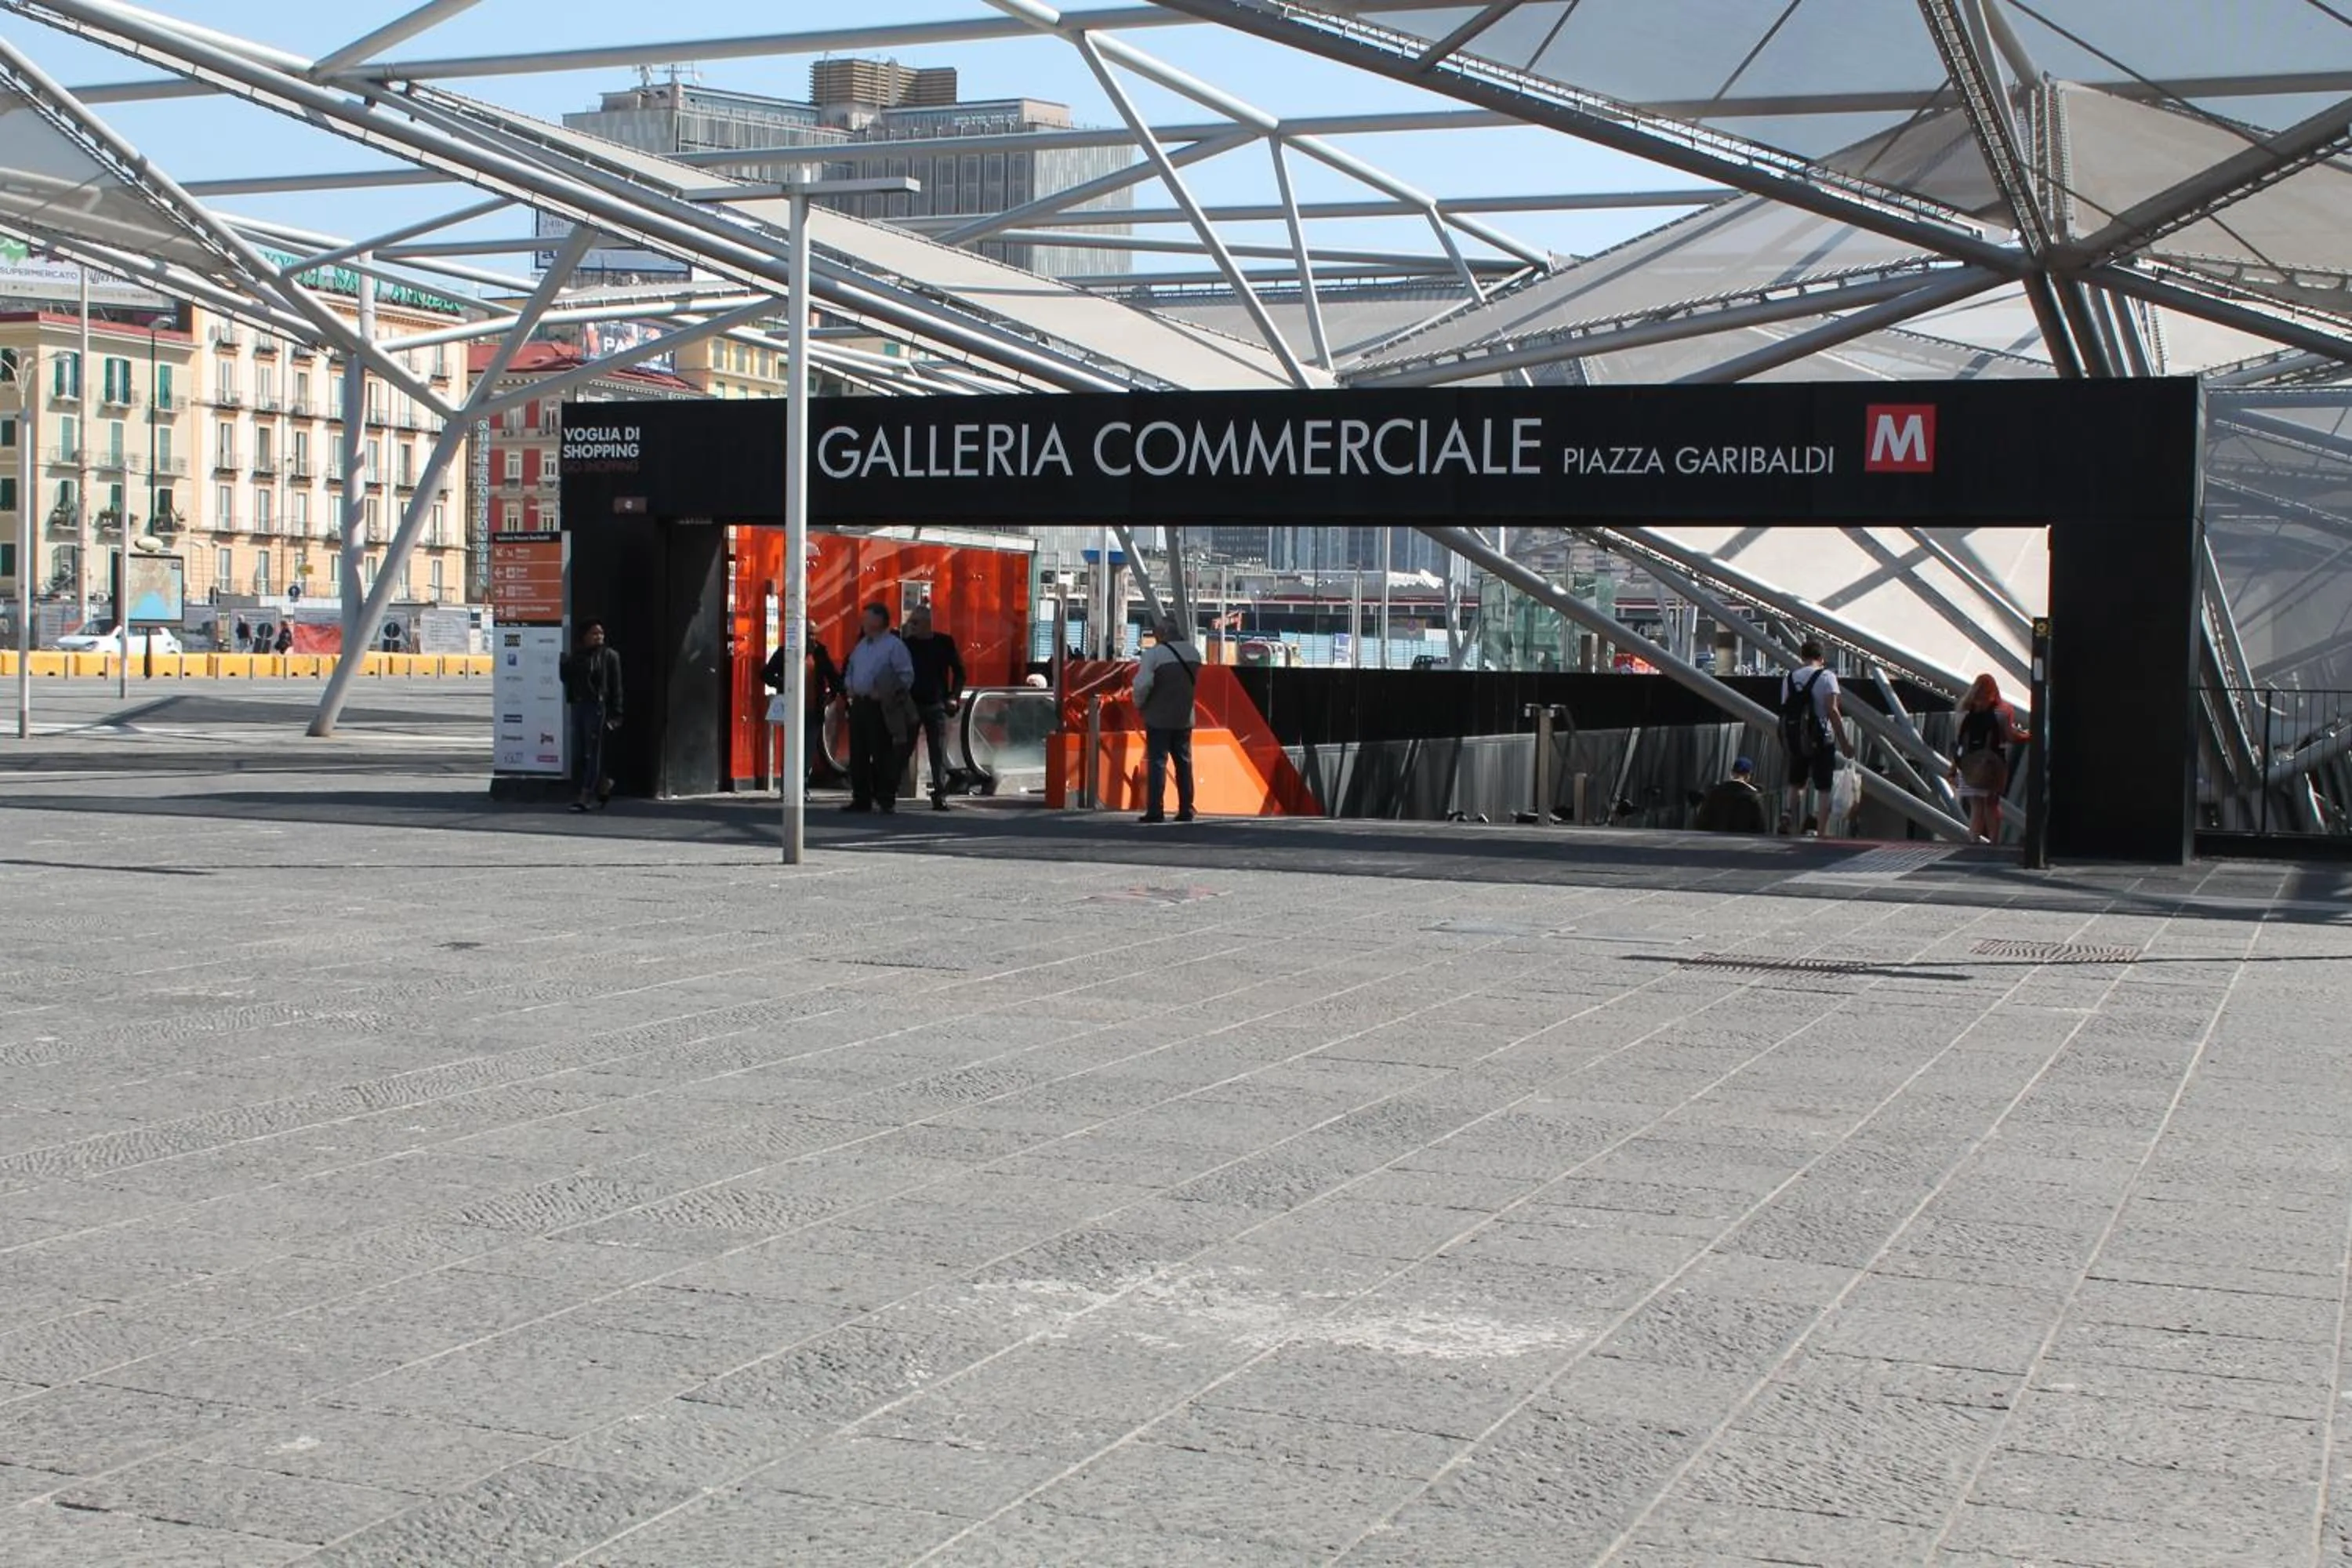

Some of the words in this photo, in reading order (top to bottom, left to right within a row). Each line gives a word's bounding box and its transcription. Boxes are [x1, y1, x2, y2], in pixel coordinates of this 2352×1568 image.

[564, 427, 621, 441] VOGLIA
[625, 426, 641, 441] DI
[818, 422, 1073, 478] GALLERIA
[1094, 418, 1542, 476] COMMERCIALE
[1563, 447, 1665, 474] PIAZZA
[1675, 446, 1835, 474] GARIBALDI
[1871, 414, 1927, 462] M
[563, 443, 639, 459] SHOPPING
